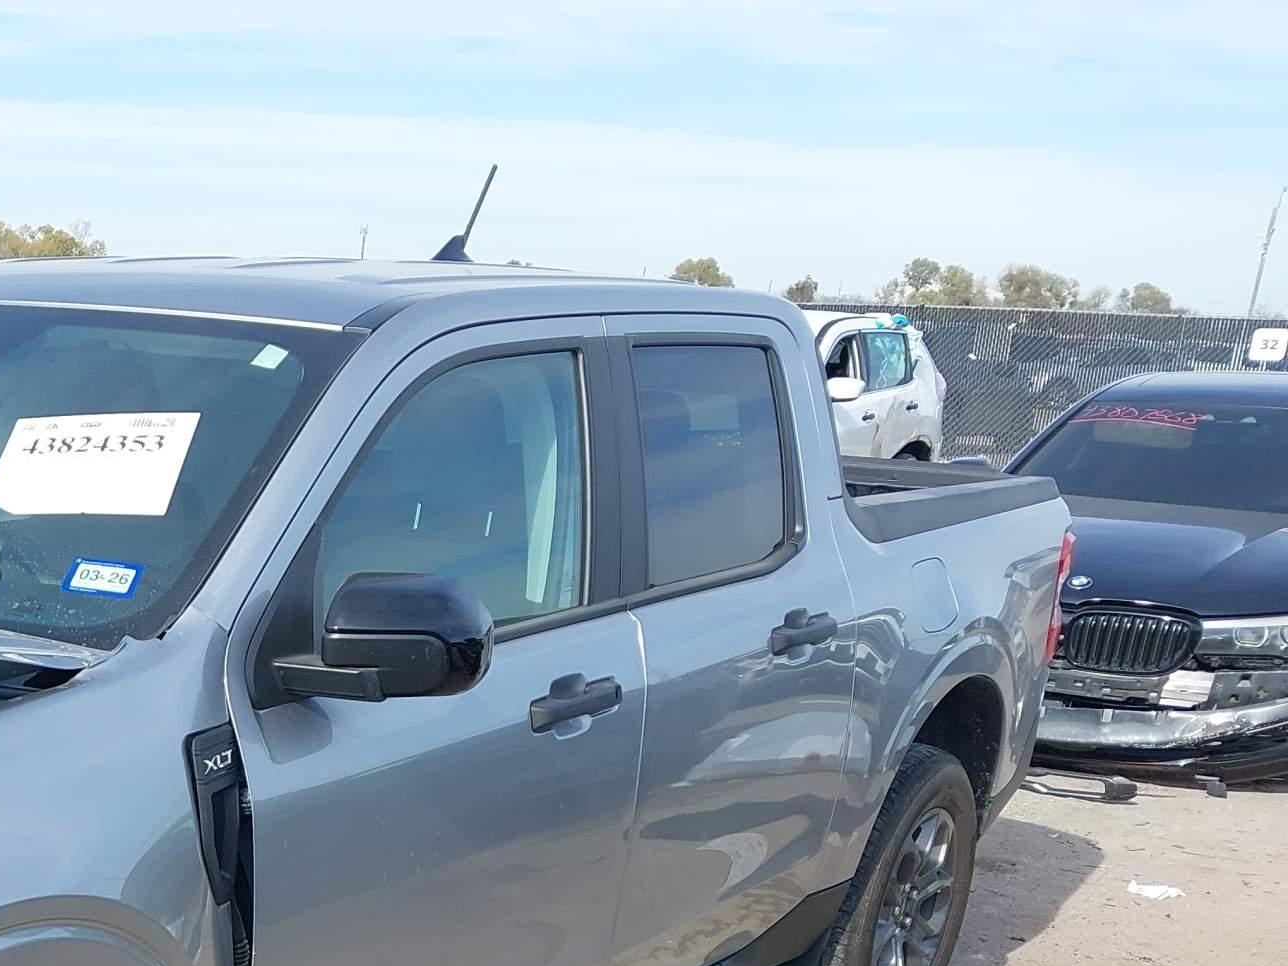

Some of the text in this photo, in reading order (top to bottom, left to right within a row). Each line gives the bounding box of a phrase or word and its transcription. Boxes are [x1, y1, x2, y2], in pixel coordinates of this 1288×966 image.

[1260, 339, 1279, 350] 32
[22, 433, 166, 455] 43824353
[203, 748, 233, 775] XLT
